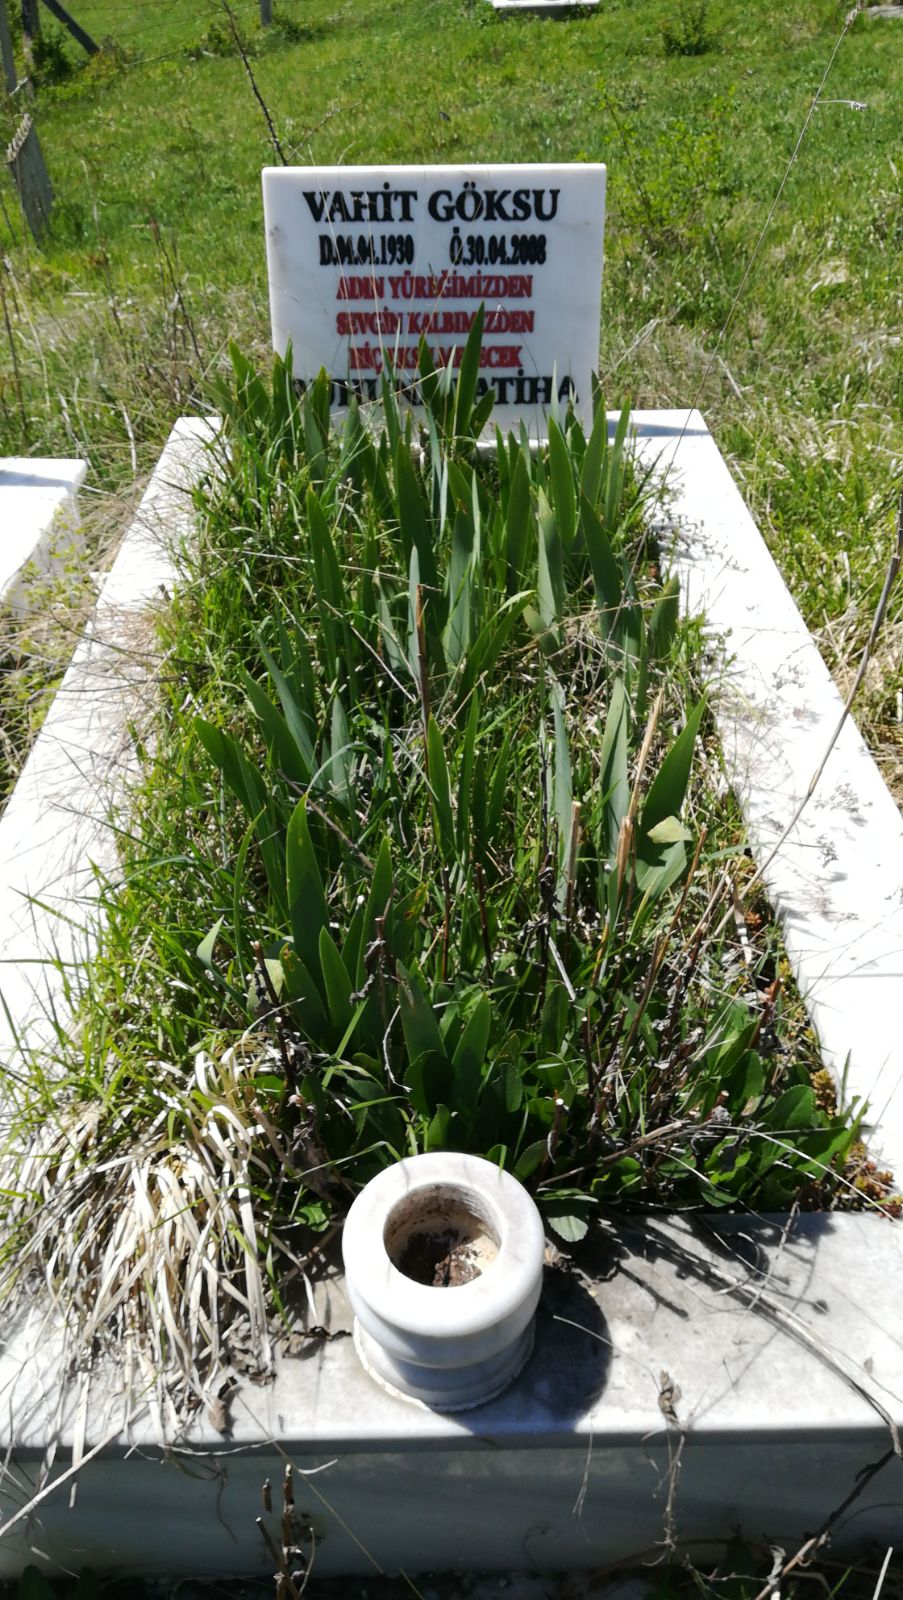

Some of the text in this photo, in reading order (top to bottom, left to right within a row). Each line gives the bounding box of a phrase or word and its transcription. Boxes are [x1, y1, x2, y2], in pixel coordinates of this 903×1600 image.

[302, 181, 560, 223] VAHİT GÖKSU
[449, 226, 547, 265] Ö.30.04.2008
[336, 269, 533, 299] ADIN YÜREĞİMİZDEN
[336, 306, 535, 335] SEVGİN KALBIMZDEN
[453, 369, 579, 406] ATİHA
